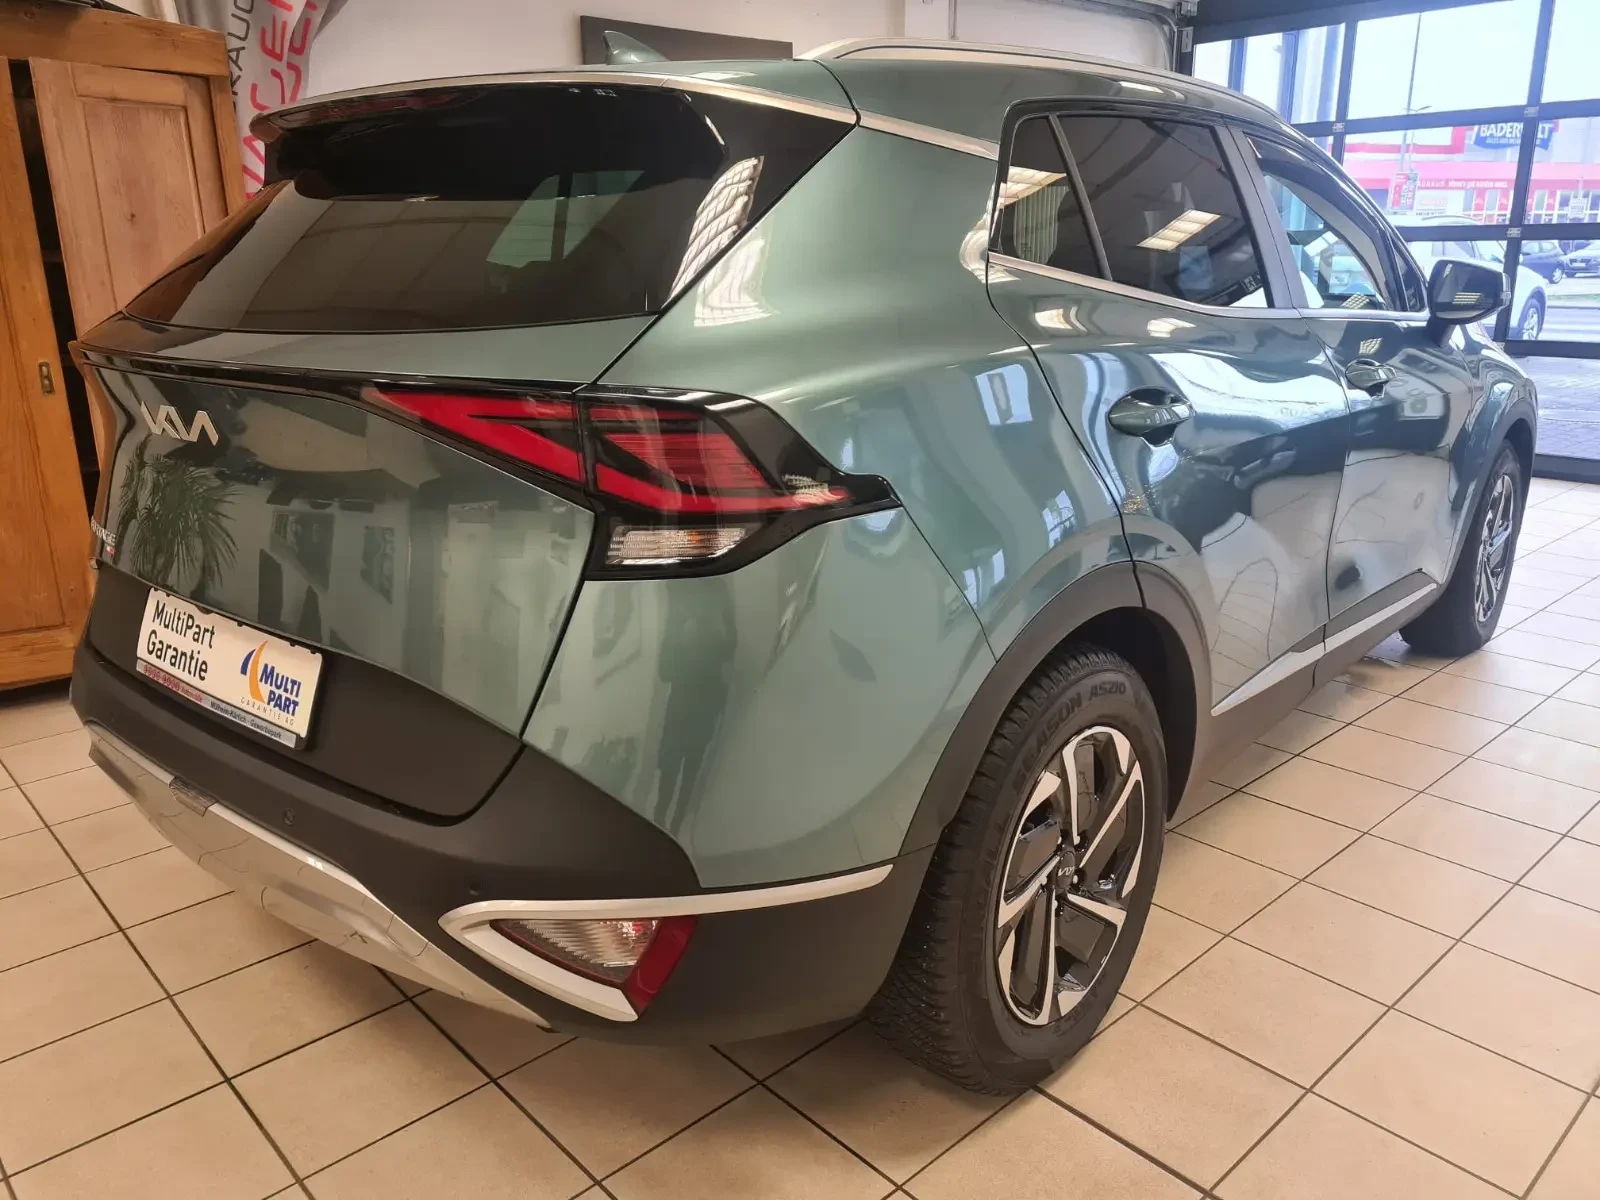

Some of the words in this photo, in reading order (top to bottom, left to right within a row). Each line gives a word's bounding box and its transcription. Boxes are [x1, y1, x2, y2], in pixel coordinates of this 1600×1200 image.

[1480, 122, 1554, 138] BADERLT
[141, 400, 218, 445] KIA
[152, 600, 215, 649] MultiPart
[146, 629, 208, 681] Garantie
[259, 663, 302, 698] MULTI
[240, 697, 281, 720] GARANTIE
[267, 689, 299, 716] PART
